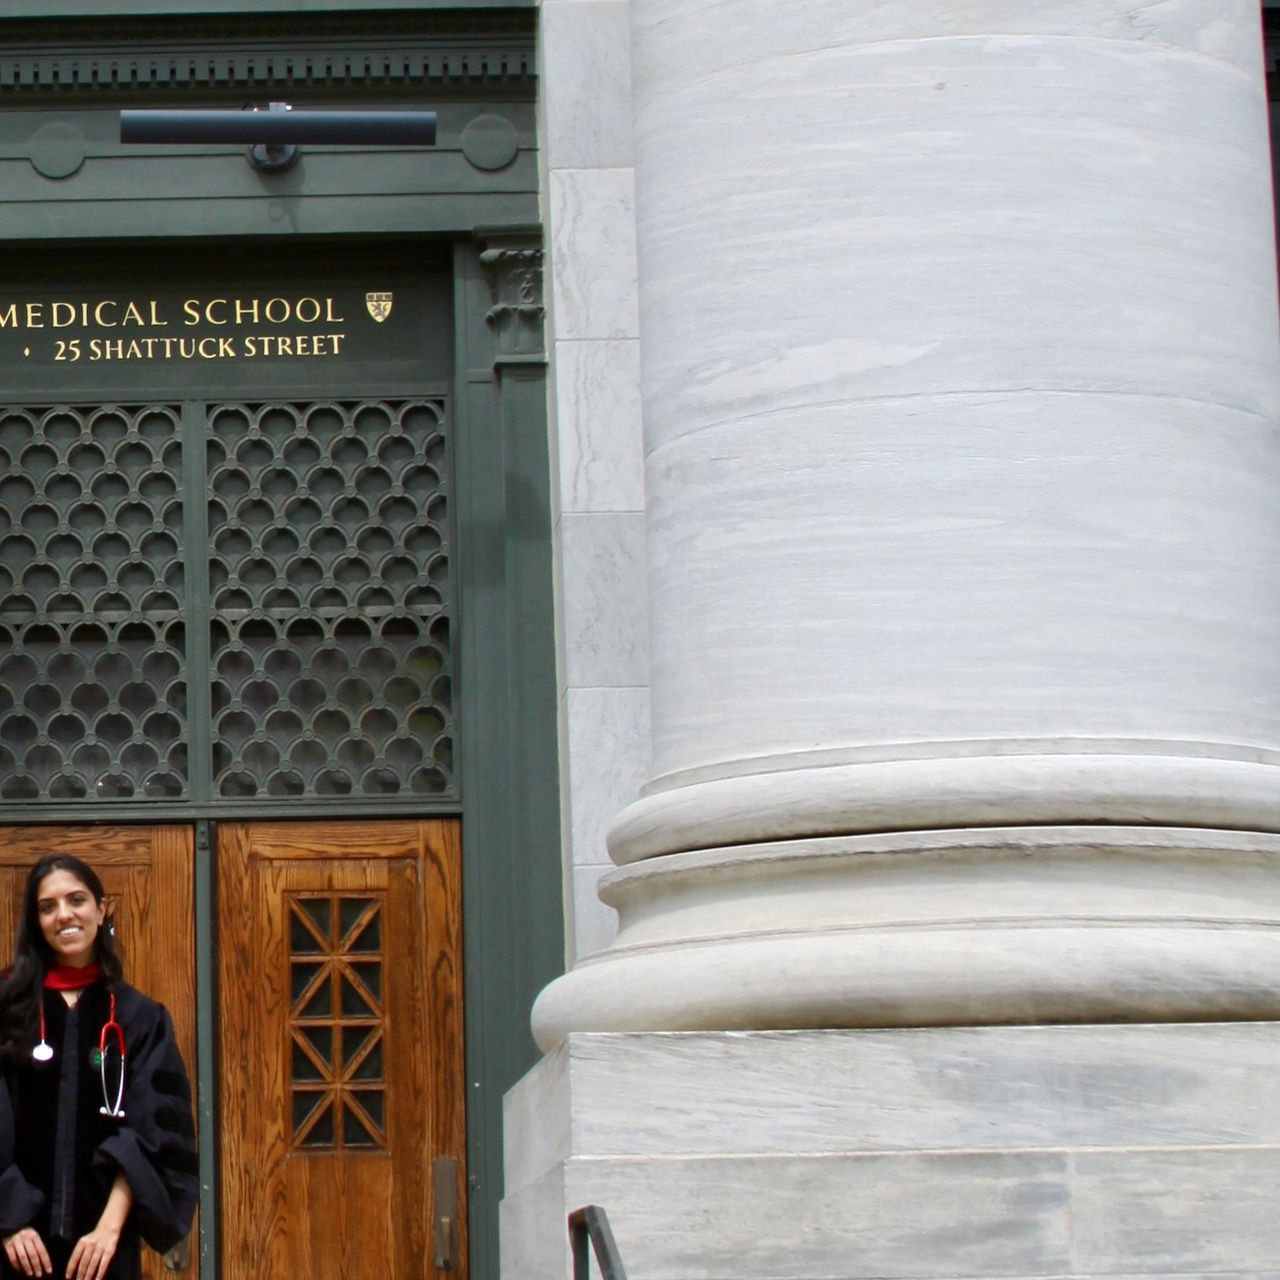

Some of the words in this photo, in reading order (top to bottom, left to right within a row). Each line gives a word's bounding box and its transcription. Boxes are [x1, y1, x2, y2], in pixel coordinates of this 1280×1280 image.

[183, 297, 345, 326] SCHOOL
[54, 339, 81, 362] 25
[89, 337, 236, 361] SHATTUCK
[244, 334, 345, 357] STREET
